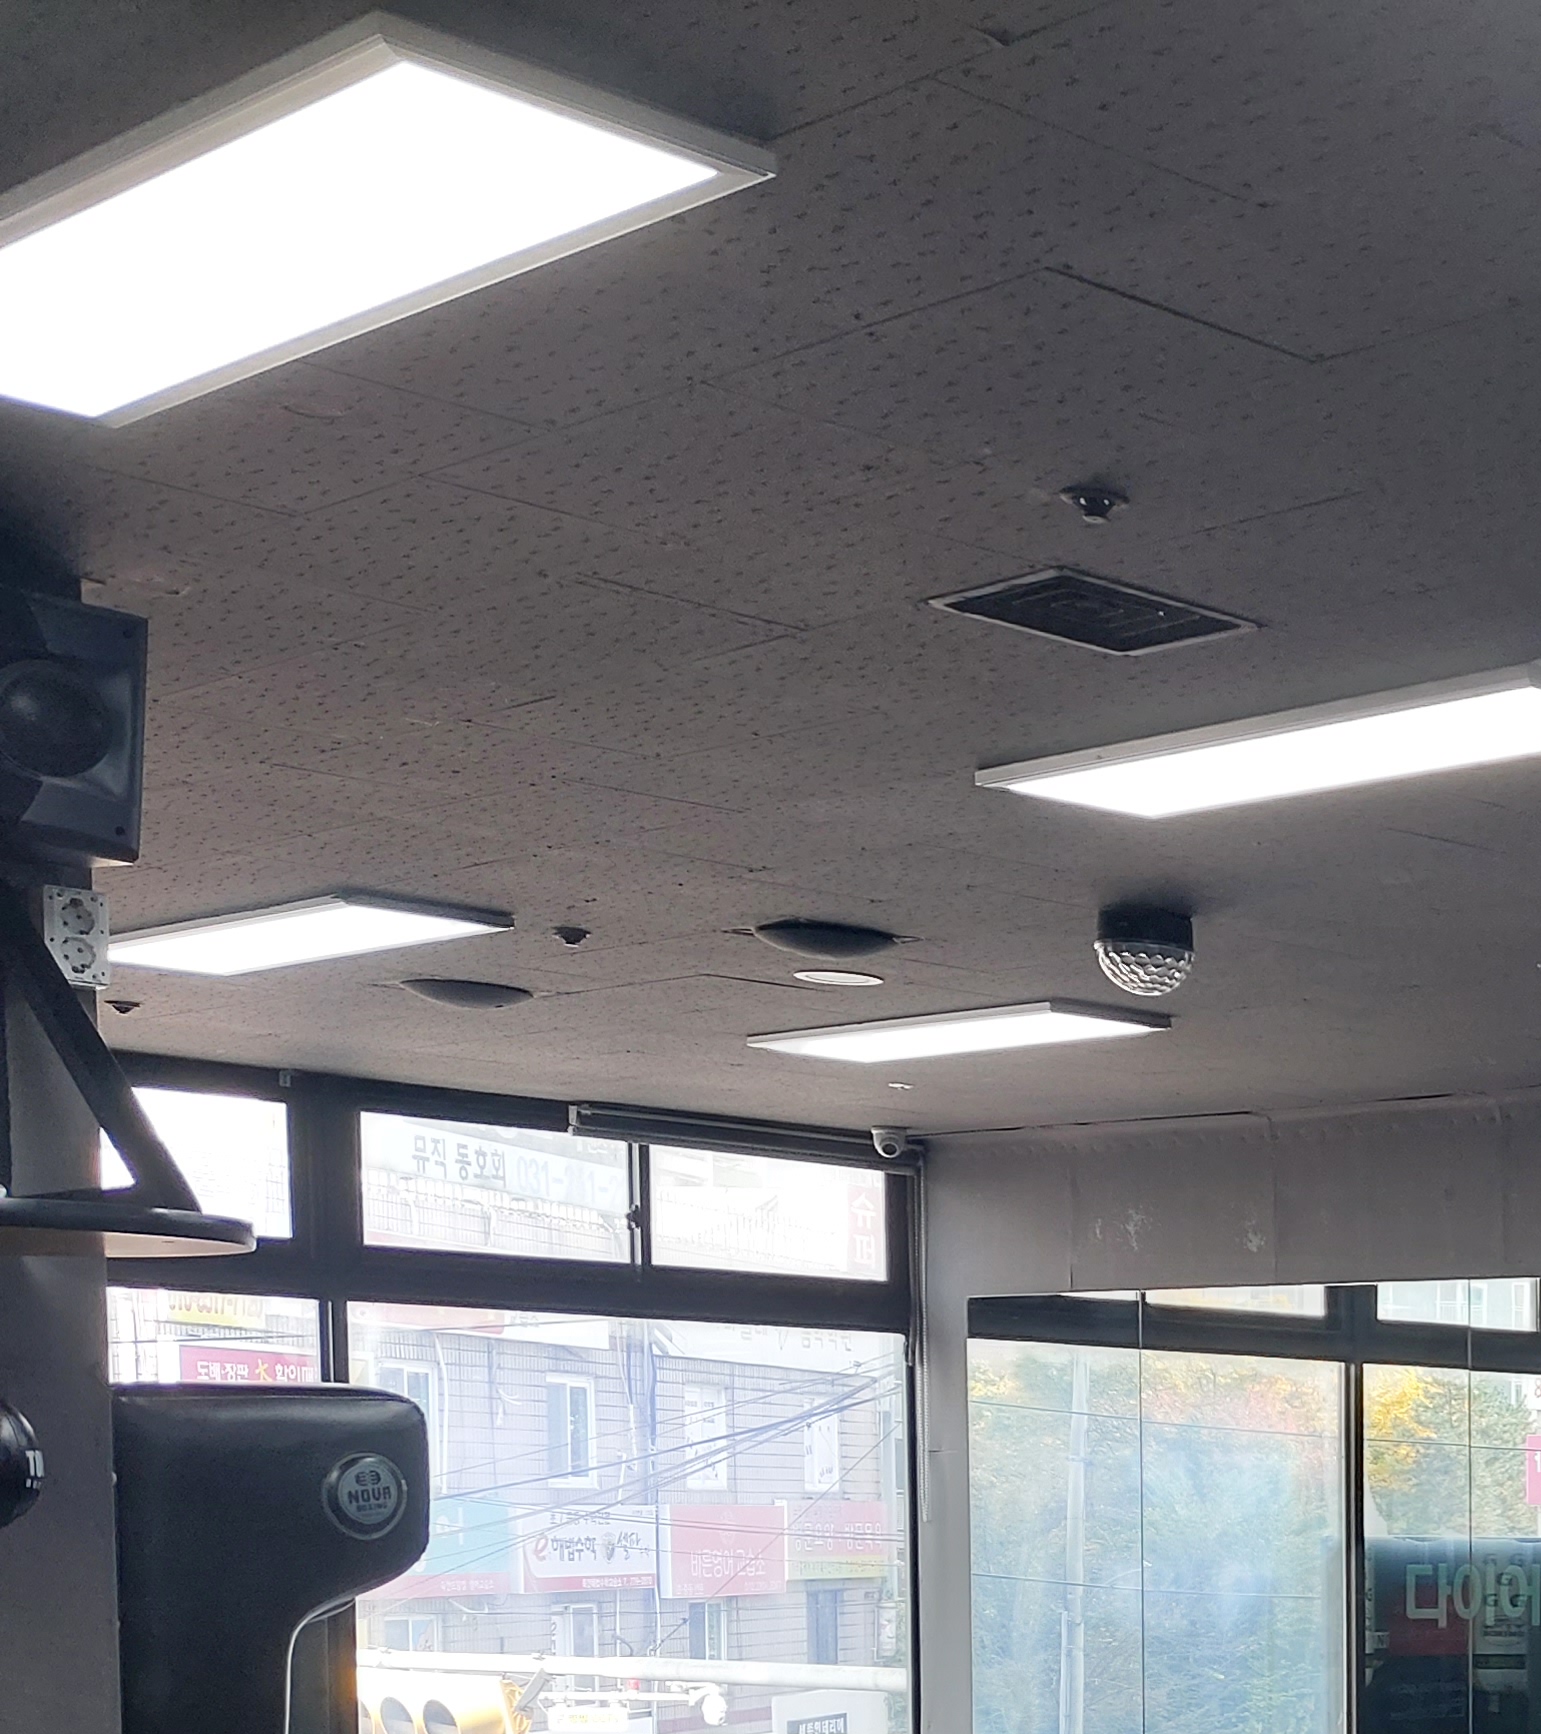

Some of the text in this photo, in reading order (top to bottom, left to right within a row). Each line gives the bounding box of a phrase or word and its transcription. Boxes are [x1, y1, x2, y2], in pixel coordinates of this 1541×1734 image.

[411, 1134, 447, 1180] 뮤직
[454, 1142, 507, 1189] 동호회
[347, 1485, 392, 1505] NOVA
[690, 1548, 736, 1579] 바른영어
[737, 1549, 767, 1577] 교습소
